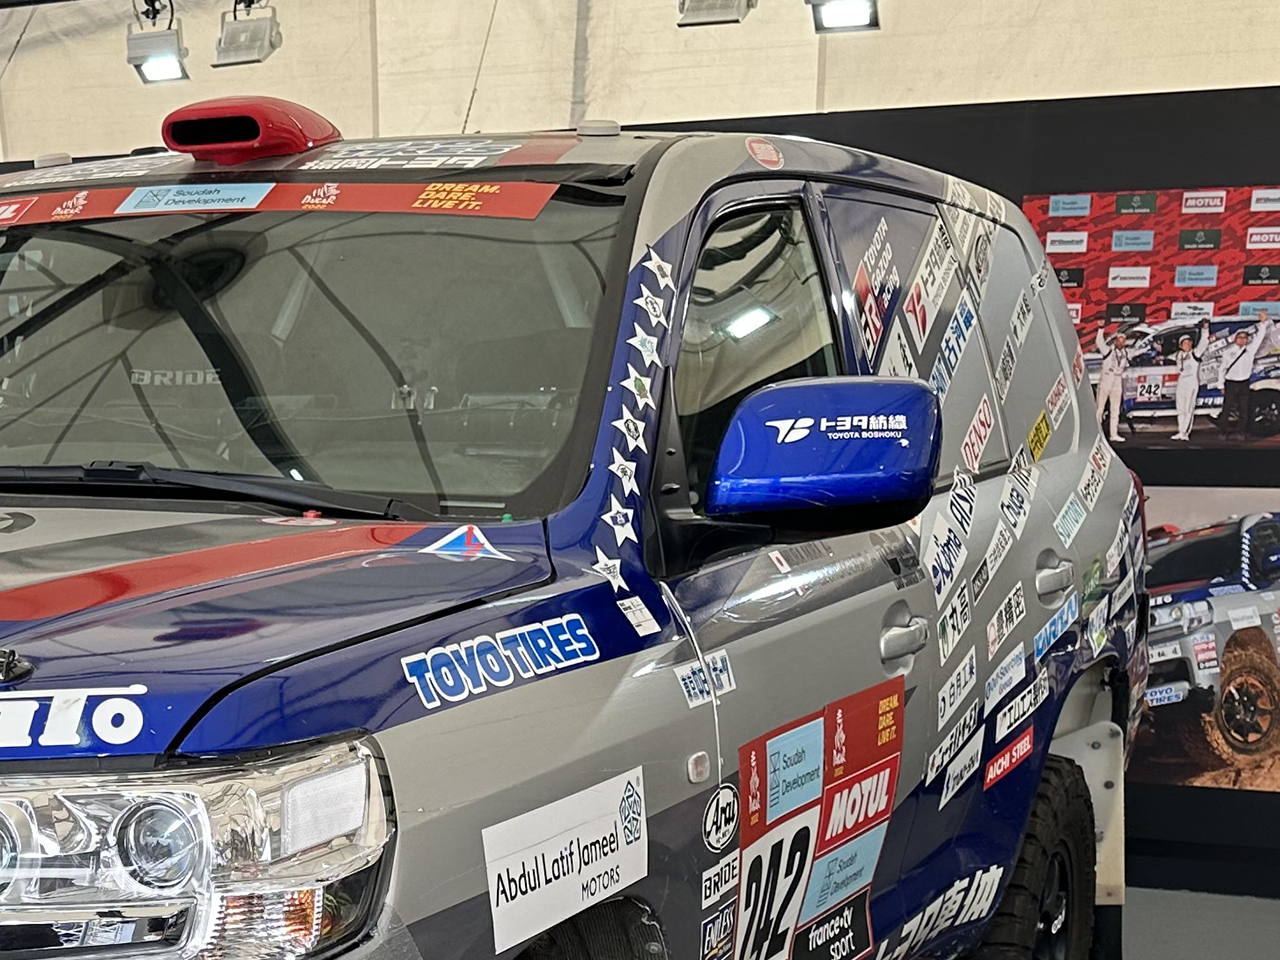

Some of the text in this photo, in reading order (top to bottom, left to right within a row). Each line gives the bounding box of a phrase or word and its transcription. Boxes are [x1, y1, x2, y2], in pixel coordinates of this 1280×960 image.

[164, 195, 247, 207] Development
[171, 188, 221, 199] Soudah
[417, 191, 477, 201] DARE.
[424, 183, 502, 193] DREAM.
[1186, 198, 1222, 207] MOTUL
[411, 199, 458, 209] LIVE
[863, 216, 888, 273] TOYOTA
[871, 242, 892, 297] GAZOO
[1139, 383, 1161, 397] 242
[820, 414, 908, 431] トヨタ紡織
[827, 431, 902, 441] TOYOTA BOSHOKU
[963, 399, 992, 473] DENSO
[404, 617, 598, 707] TOYO TIRES
[782, 744, 806, 770] Soudah
[987, 753, 1011, 784] AICHI
[1011, 734, 1032, 764] STEEL
[824, 767, 891, 842] MOTUL
[496, 819, 620, 908] Abdul Latif Jameel
[703, 856, 738, 893] BRIDE
[581, 864, 621, 902] MOTORS
[704, 903, 735, 955] ENDLESS
